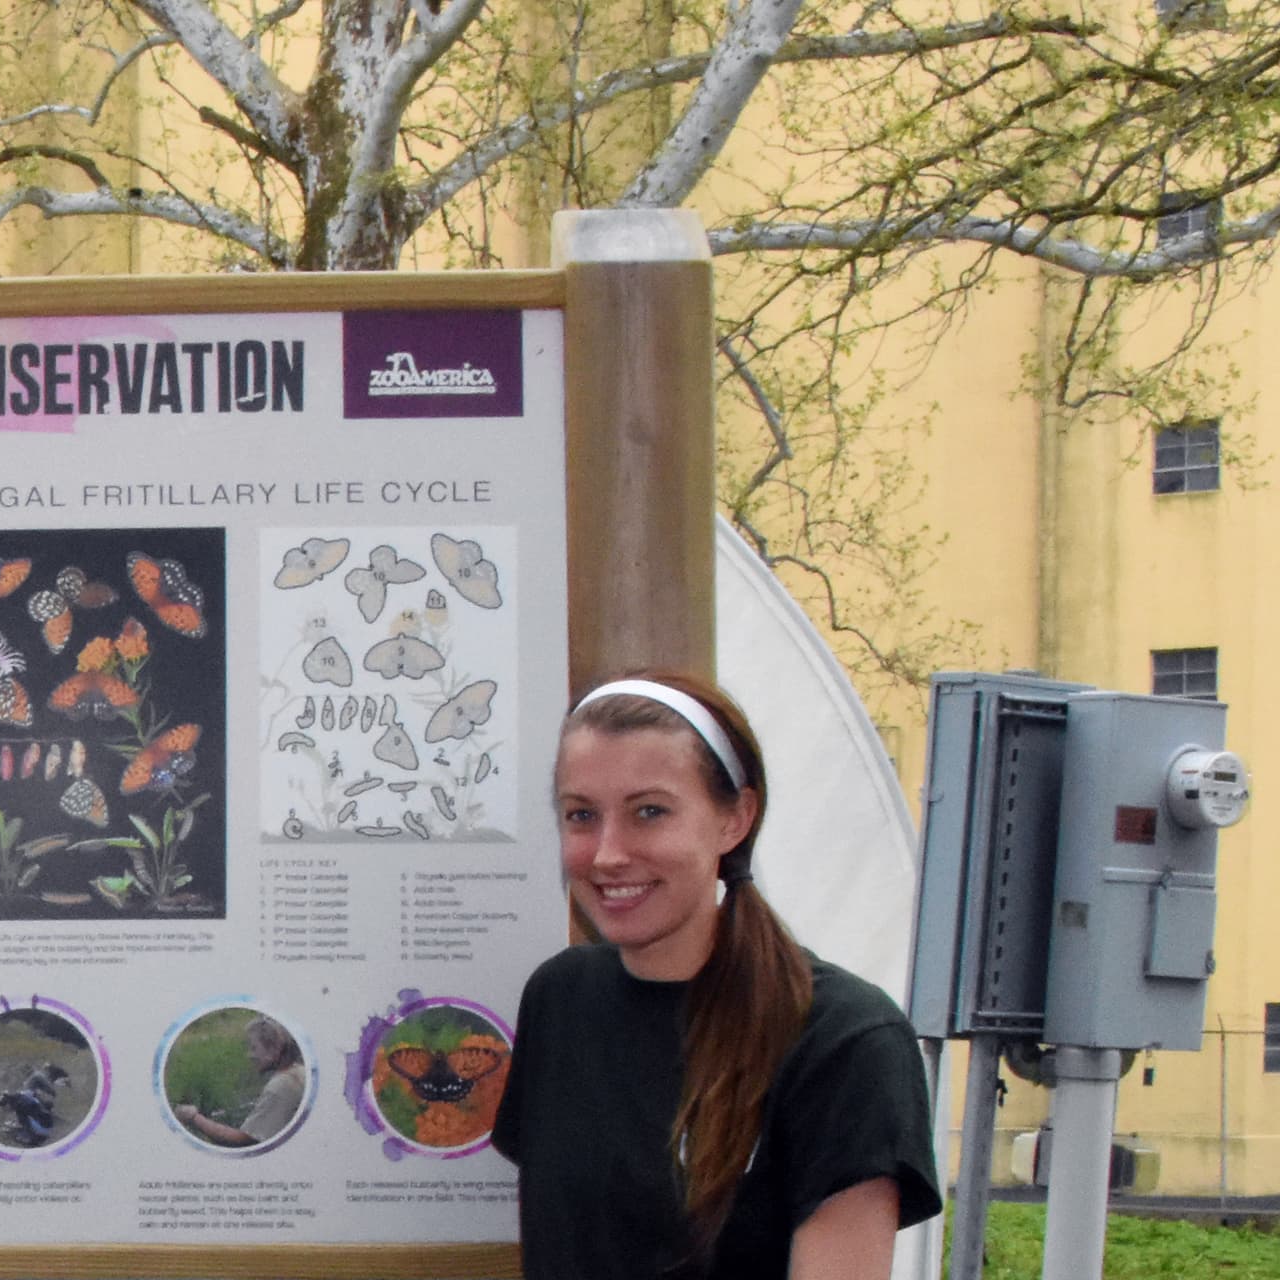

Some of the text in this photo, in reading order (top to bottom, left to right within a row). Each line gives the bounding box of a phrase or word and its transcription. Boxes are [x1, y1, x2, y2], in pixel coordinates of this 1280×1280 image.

[83, 483, 277, 506] FRITILLARY
[294, 481, 365, 504] LIFE
[381, 480, 492, 503] CYCLE
